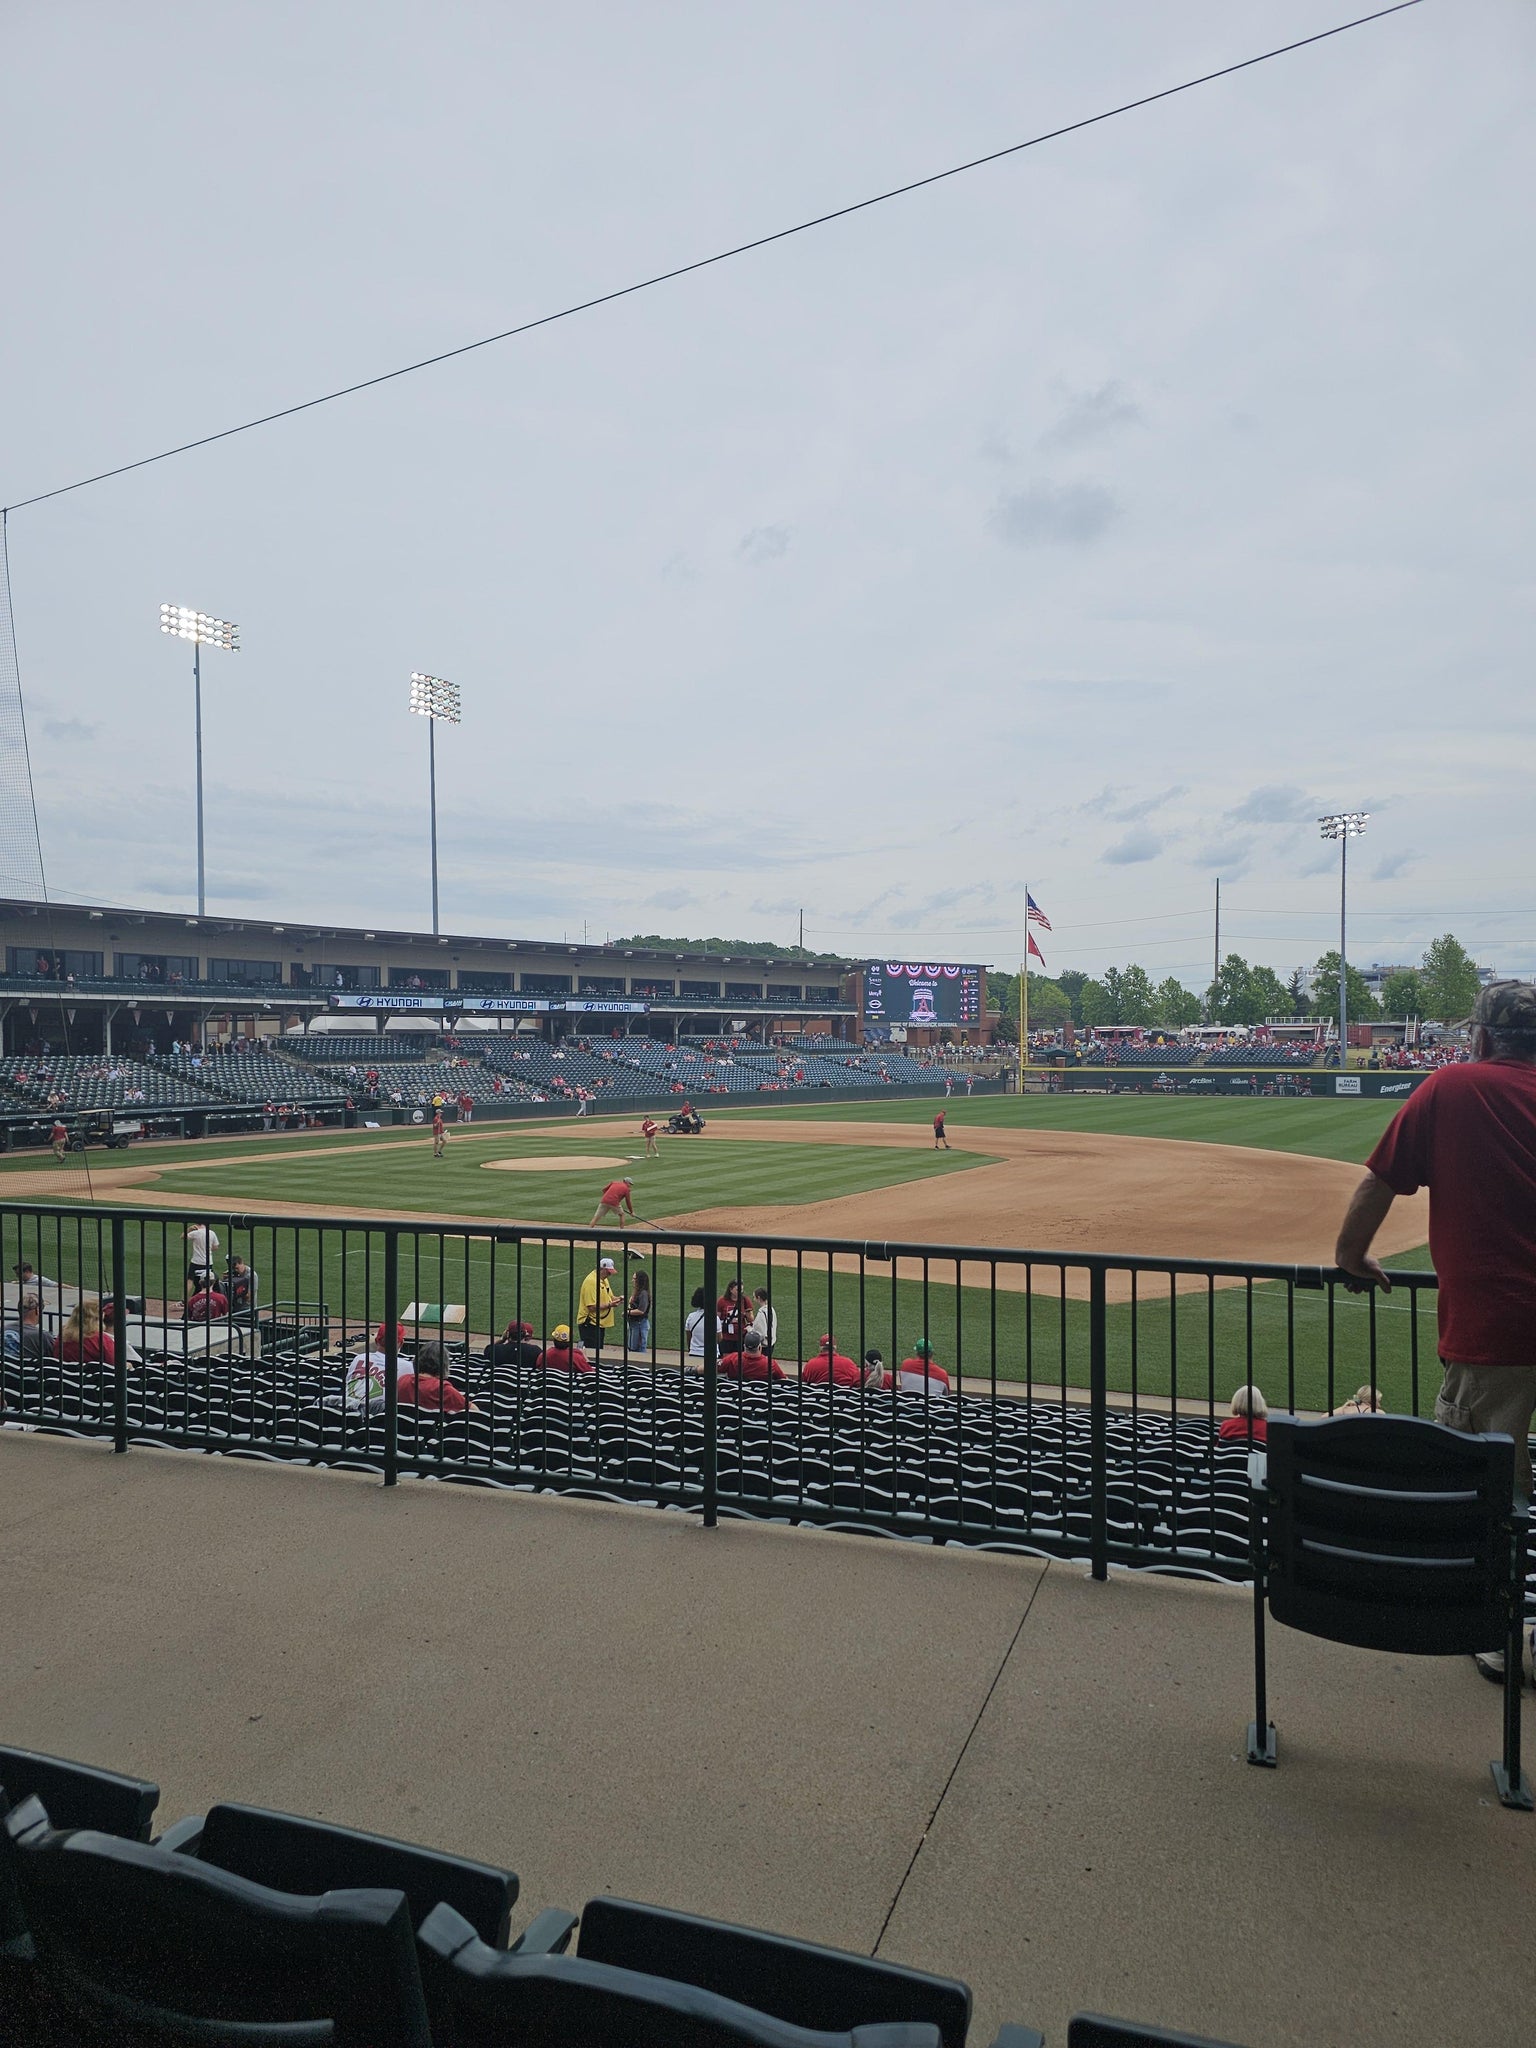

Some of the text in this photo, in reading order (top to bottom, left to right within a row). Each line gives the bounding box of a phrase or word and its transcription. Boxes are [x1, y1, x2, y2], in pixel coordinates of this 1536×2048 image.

[908, 979, 931, 987] Welcome
[376, 998, 423, 1008] HYUNDAI
[497, 1001, 537, 1010] HYUNDAI
[597, 1003, 632, 1012] HYUNDAI
[1380, 1082, 1412, 1094] Energizer
